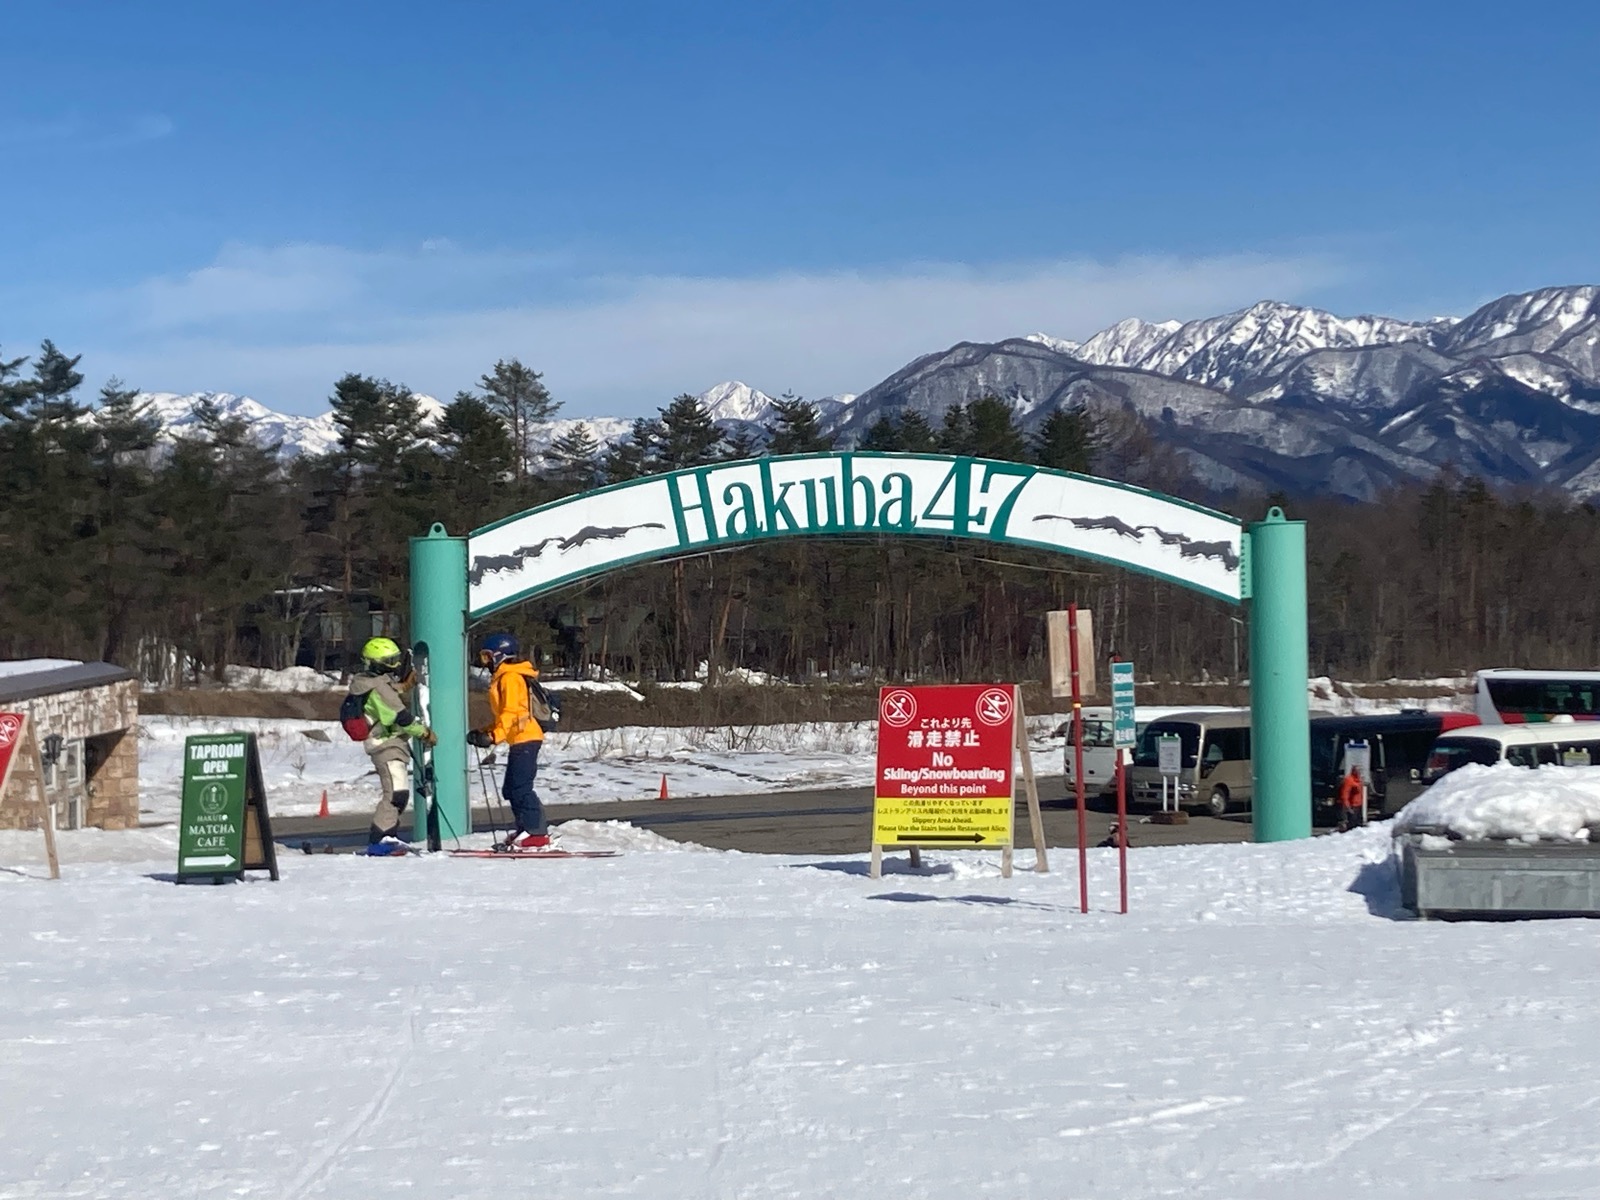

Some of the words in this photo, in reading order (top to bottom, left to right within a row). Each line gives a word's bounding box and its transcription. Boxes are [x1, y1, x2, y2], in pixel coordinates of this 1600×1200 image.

[920, 716, 972, 728] これより先
[907, 729, 980, 748] 滑走禁止
[190, 743, 245, 760] TAPROOM
[932, 751, 954, 767] No
[203, 760, 229, 774] OPEN
[883, 767, 1005, 783] Skiing/Snowboarding
[901, 784, 937, 796] Beyond
[939, 783, 958, 794] this
[959, 784, 986, 796] point
[188, 823, 236, 836] MATCHA
[197, 836, 226, 847] CAFE
